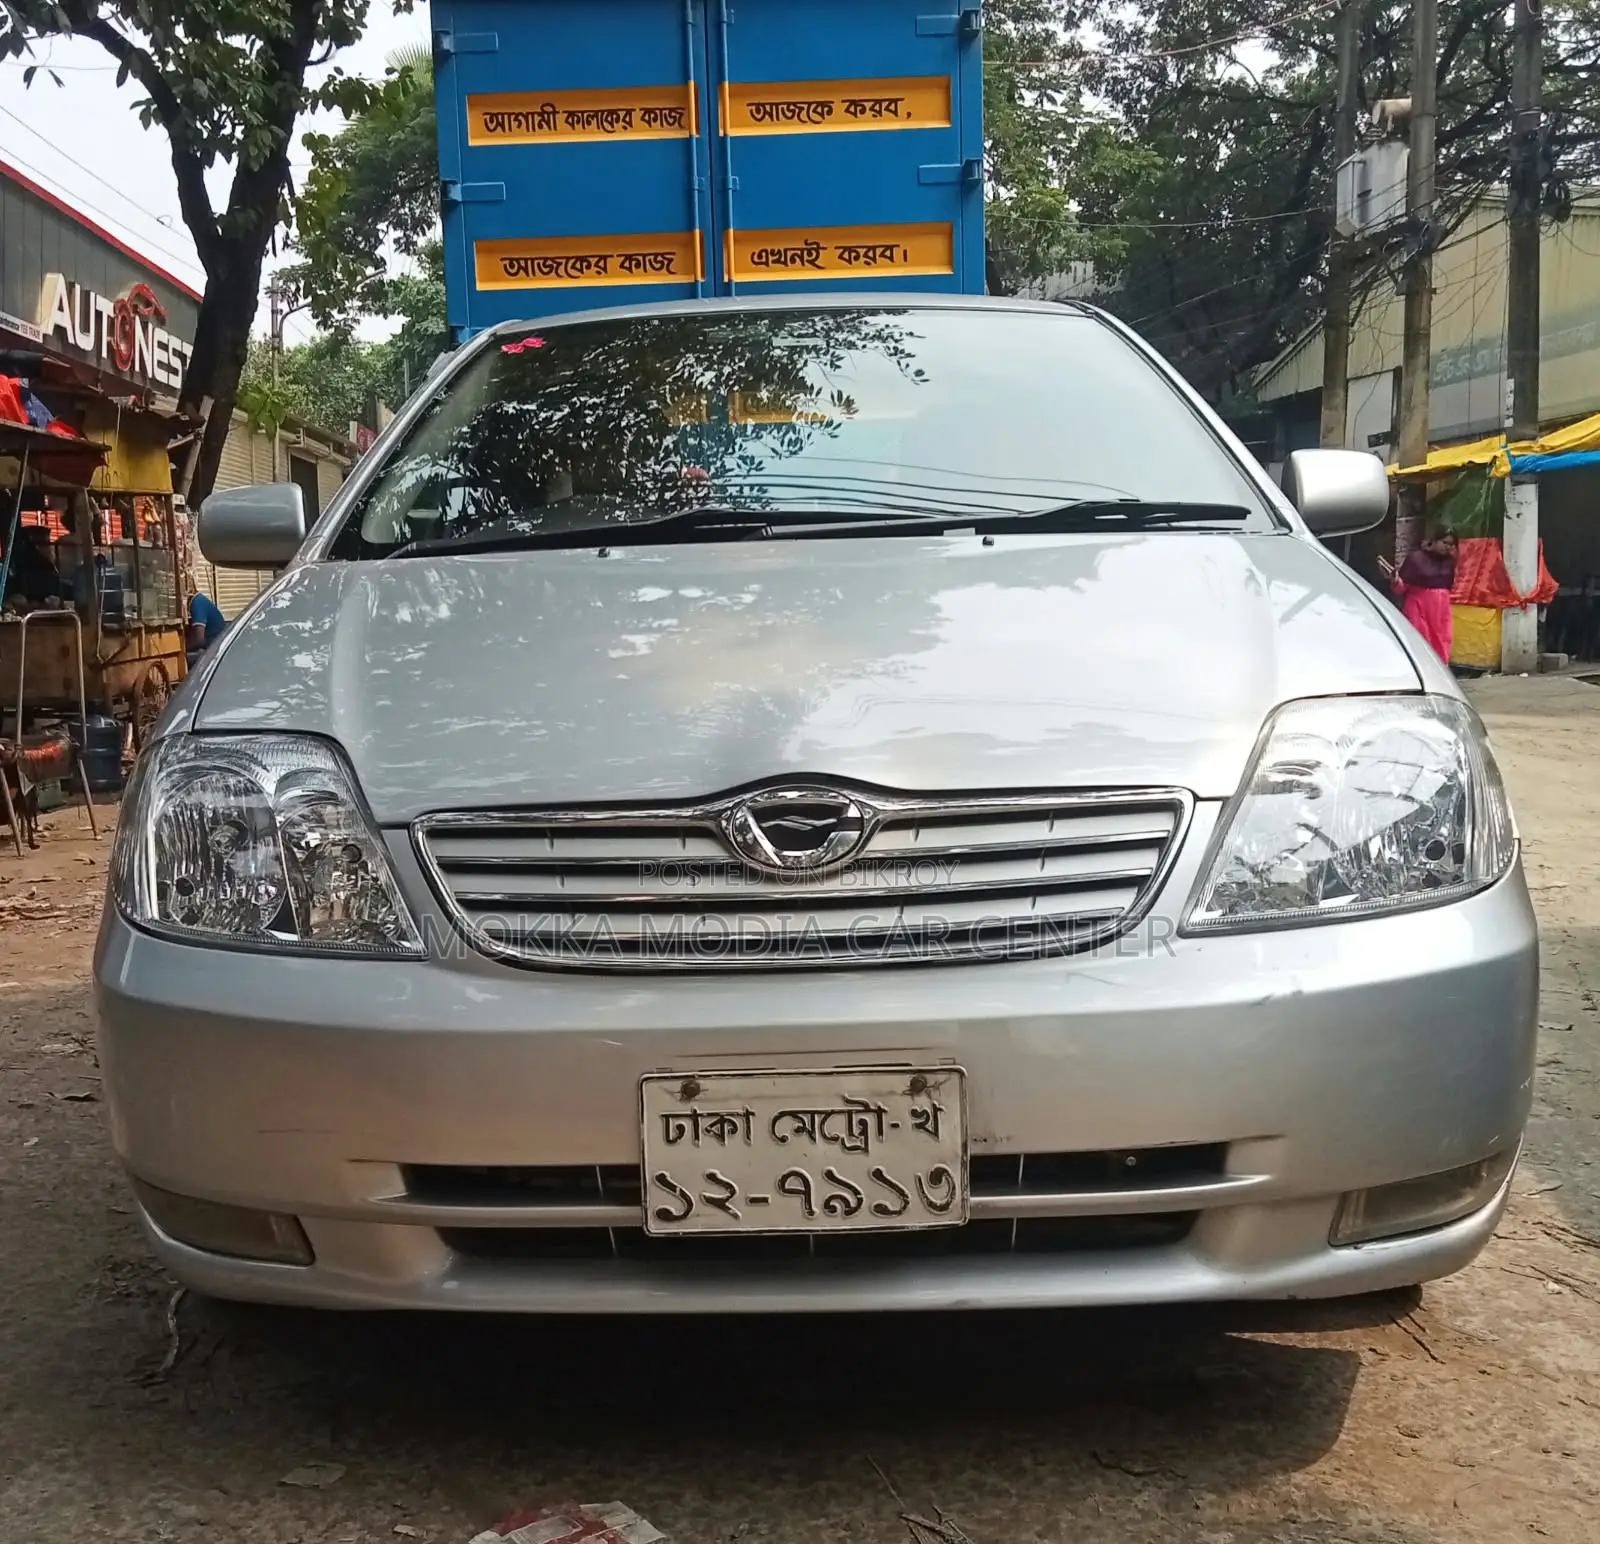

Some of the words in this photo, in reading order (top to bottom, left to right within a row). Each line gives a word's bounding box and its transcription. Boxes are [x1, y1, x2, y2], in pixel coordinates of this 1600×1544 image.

[482, 102, 560, 133] আগামী
[562, 107, 636, 134] কালকের
[639, 106, 687, 129] কাজ
[746, 100, 834, 125] আজকে
[500, 254, 614, 280] আজকের
[616, 251, 677, 275] কাজ
[751, 239, 828, 270] এখনই
[660, 1105, 755, 1146] ঢাকা
[654, 1164, 958, 1222] ১২-৭৯১৩
